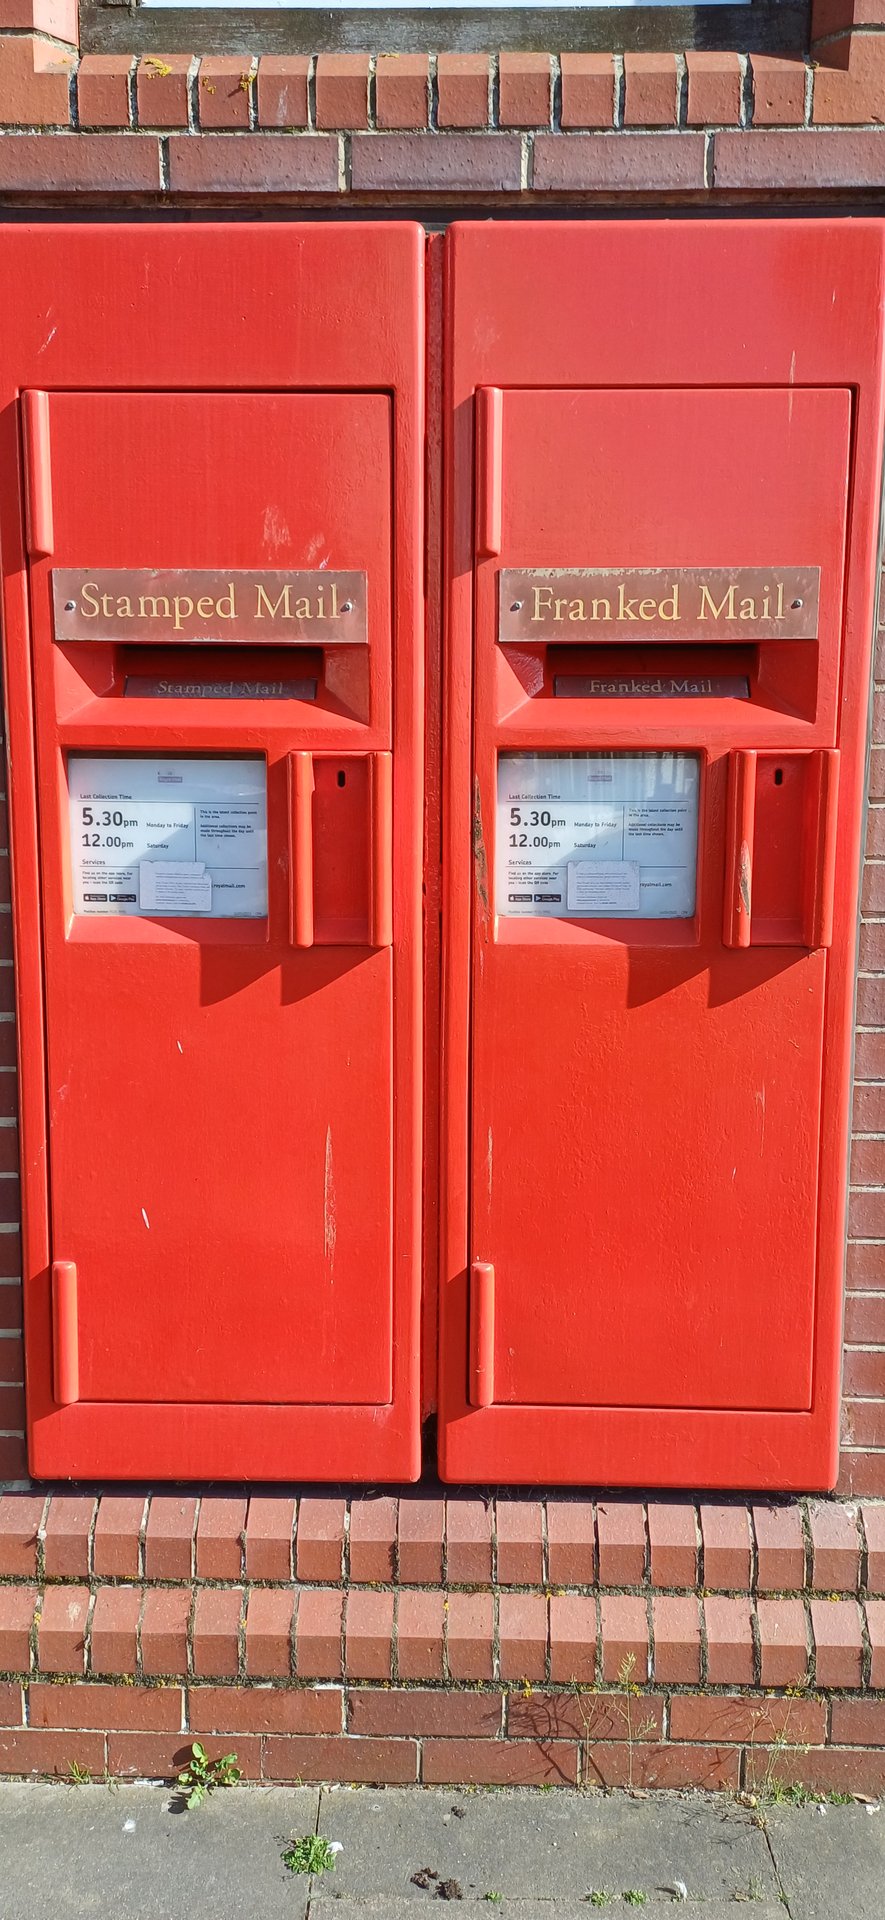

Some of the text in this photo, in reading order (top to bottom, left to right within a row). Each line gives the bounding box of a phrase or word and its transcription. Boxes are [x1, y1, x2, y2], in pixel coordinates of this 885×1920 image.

[80, 582, 340, 630] Stamped Mail
[531, 583, 785, 621] Franked Mail
[157, 681, 283, 696] Stamped Mail
[589, 680, 712, 694] Franked Mail
[82, 807, 138, 828] 5.30pm
[510, 807, 566, 828] 5.30pm
[81, 833, 134, 849] 12.00pm
[509, 833, 561, 849] 12.00pm
